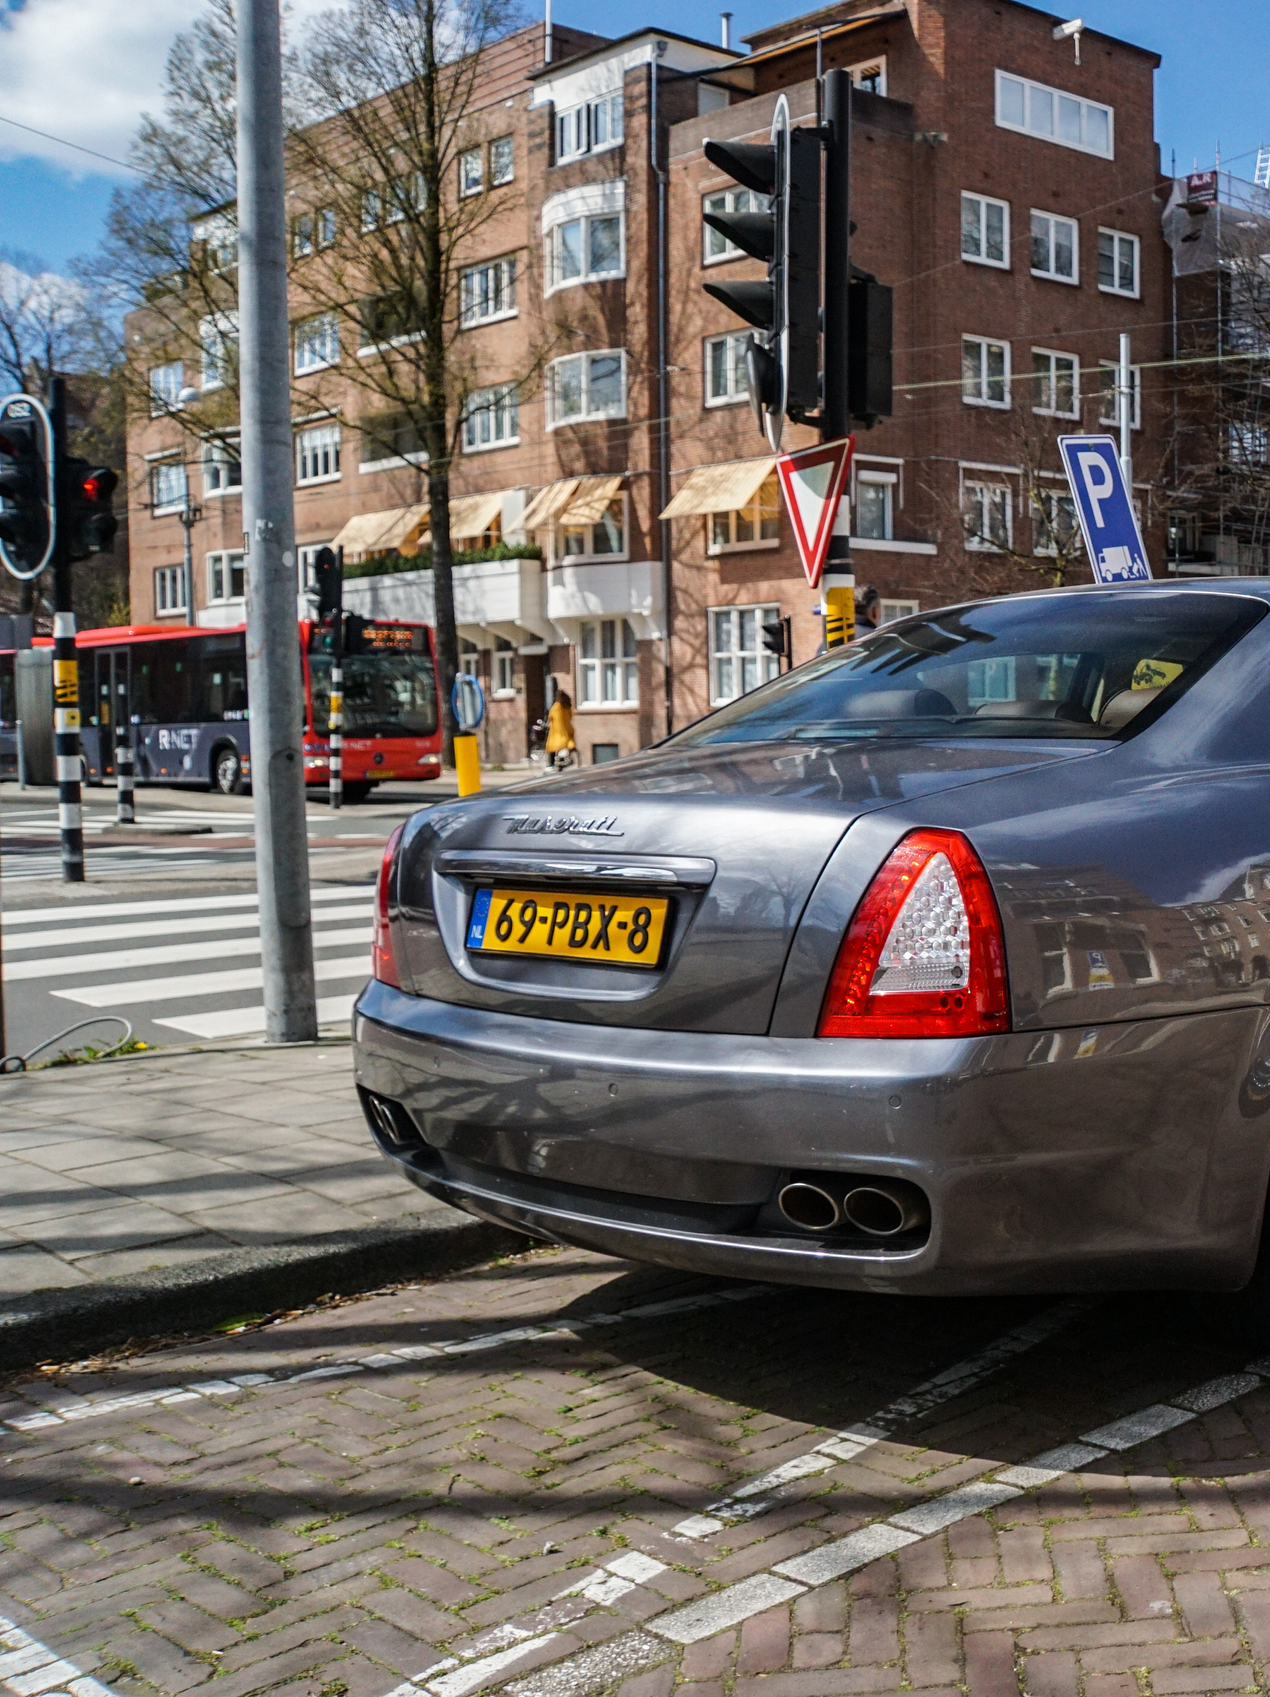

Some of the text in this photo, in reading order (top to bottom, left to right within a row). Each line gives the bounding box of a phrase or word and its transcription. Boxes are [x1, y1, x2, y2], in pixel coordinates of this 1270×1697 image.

[1076, 451, 1114, 529] P
[502, 814, 625, 837] Maserati
[471, 898, 652, 954] NL 69-PBX-8
